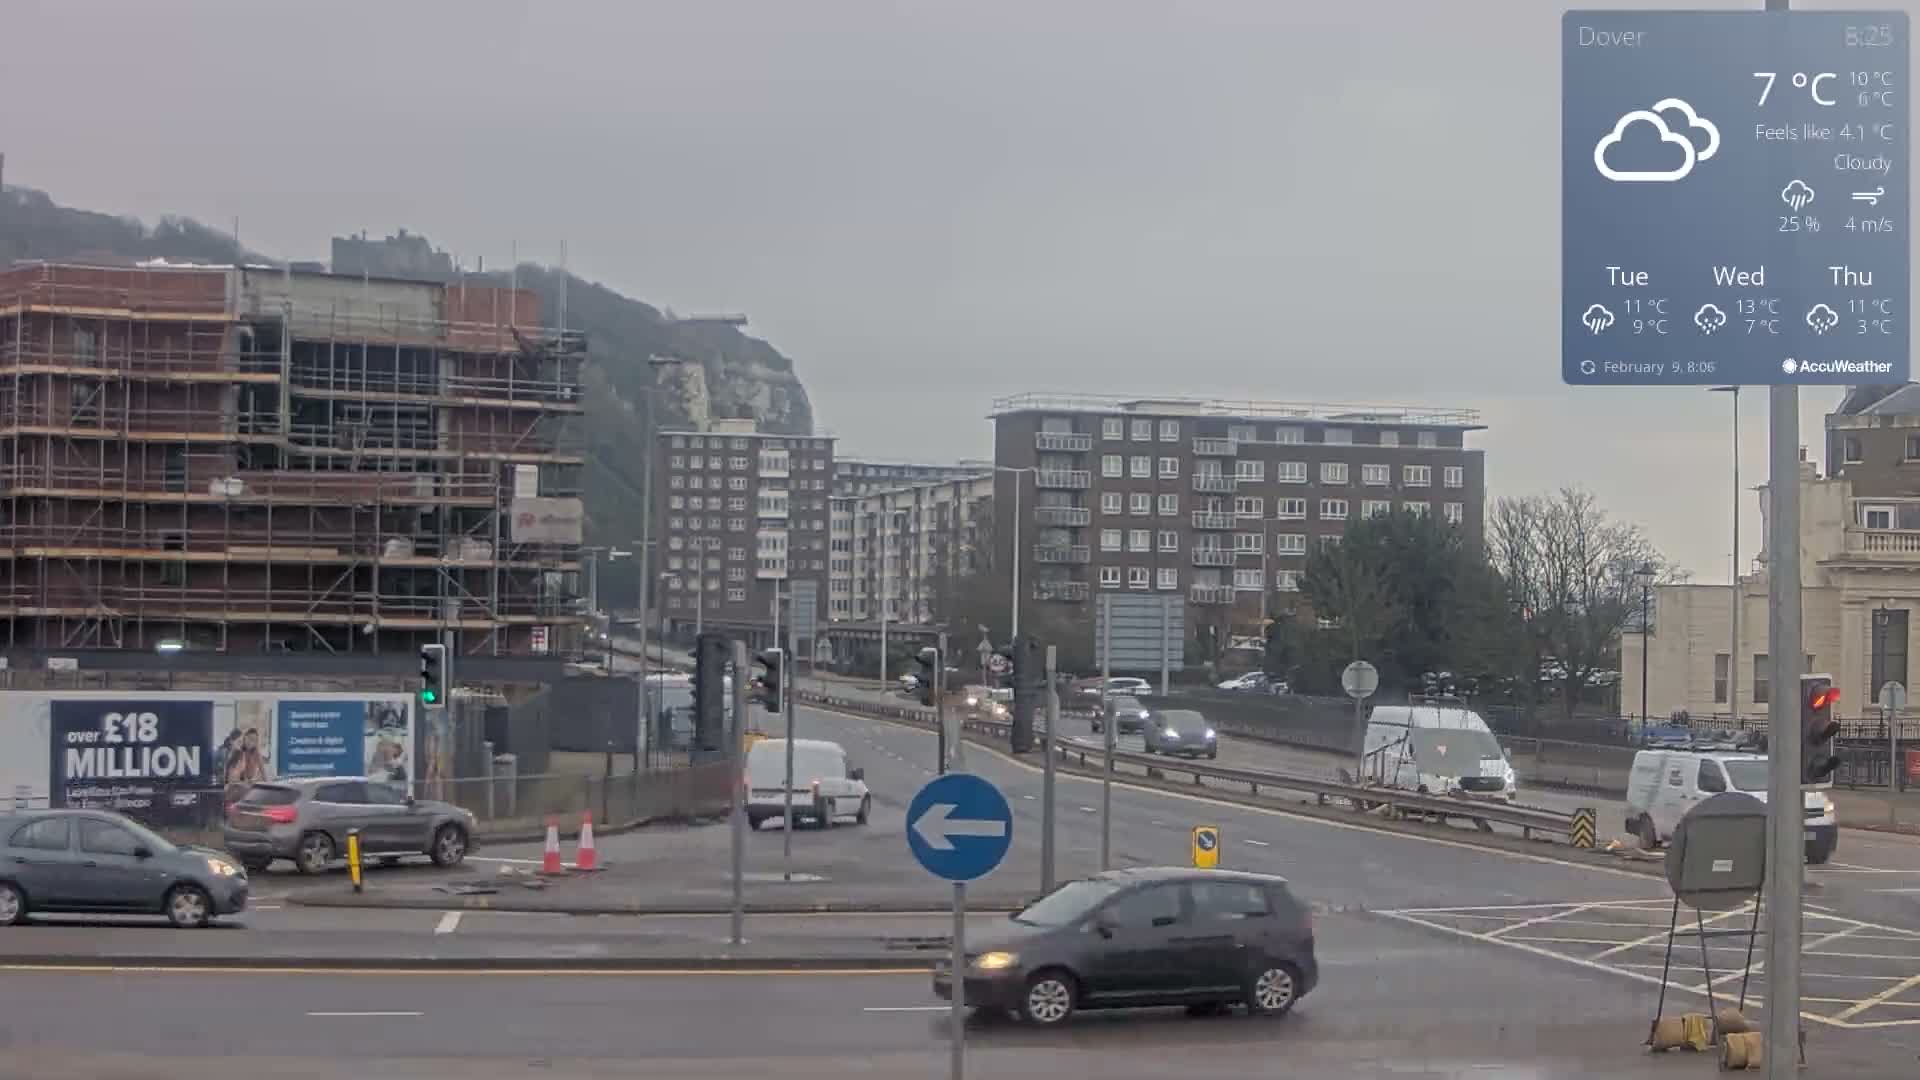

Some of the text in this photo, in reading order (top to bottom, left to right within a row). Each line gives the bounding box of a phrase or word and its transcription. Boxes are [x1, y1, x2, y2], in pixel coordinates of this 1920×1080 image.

[67, 711, 159, 743] over £18
[67, 745, 201, 778] MILLION
